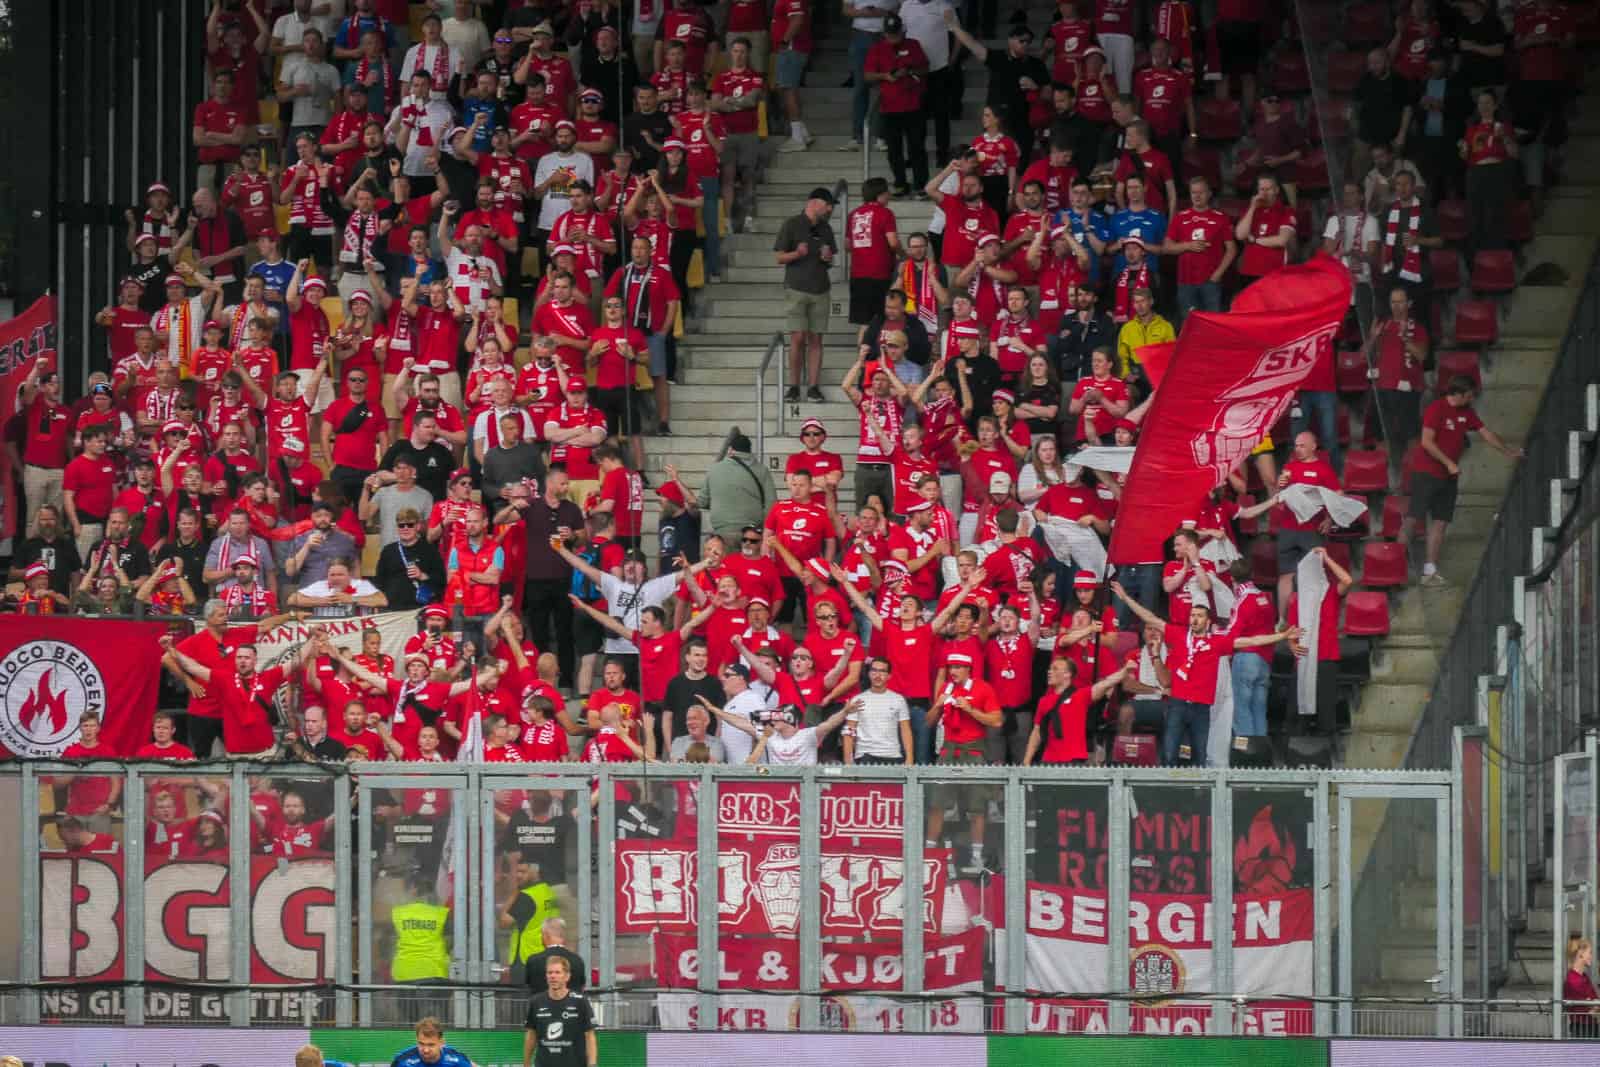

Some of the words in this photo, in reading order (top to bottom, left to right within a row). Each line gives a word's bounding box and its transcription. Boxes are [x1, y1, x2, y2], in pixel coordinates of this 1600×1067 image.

[791, 405, 800, 417] 14
[769, 457, 779, 469] 13
[720, 793, 774, 825] SKB
[41, 857, 336, 981] BGG
[758, 950, 789, 981] &
[820, 944, 965, 984] KJØT
[88, 991, 192, 1017] GLDE
